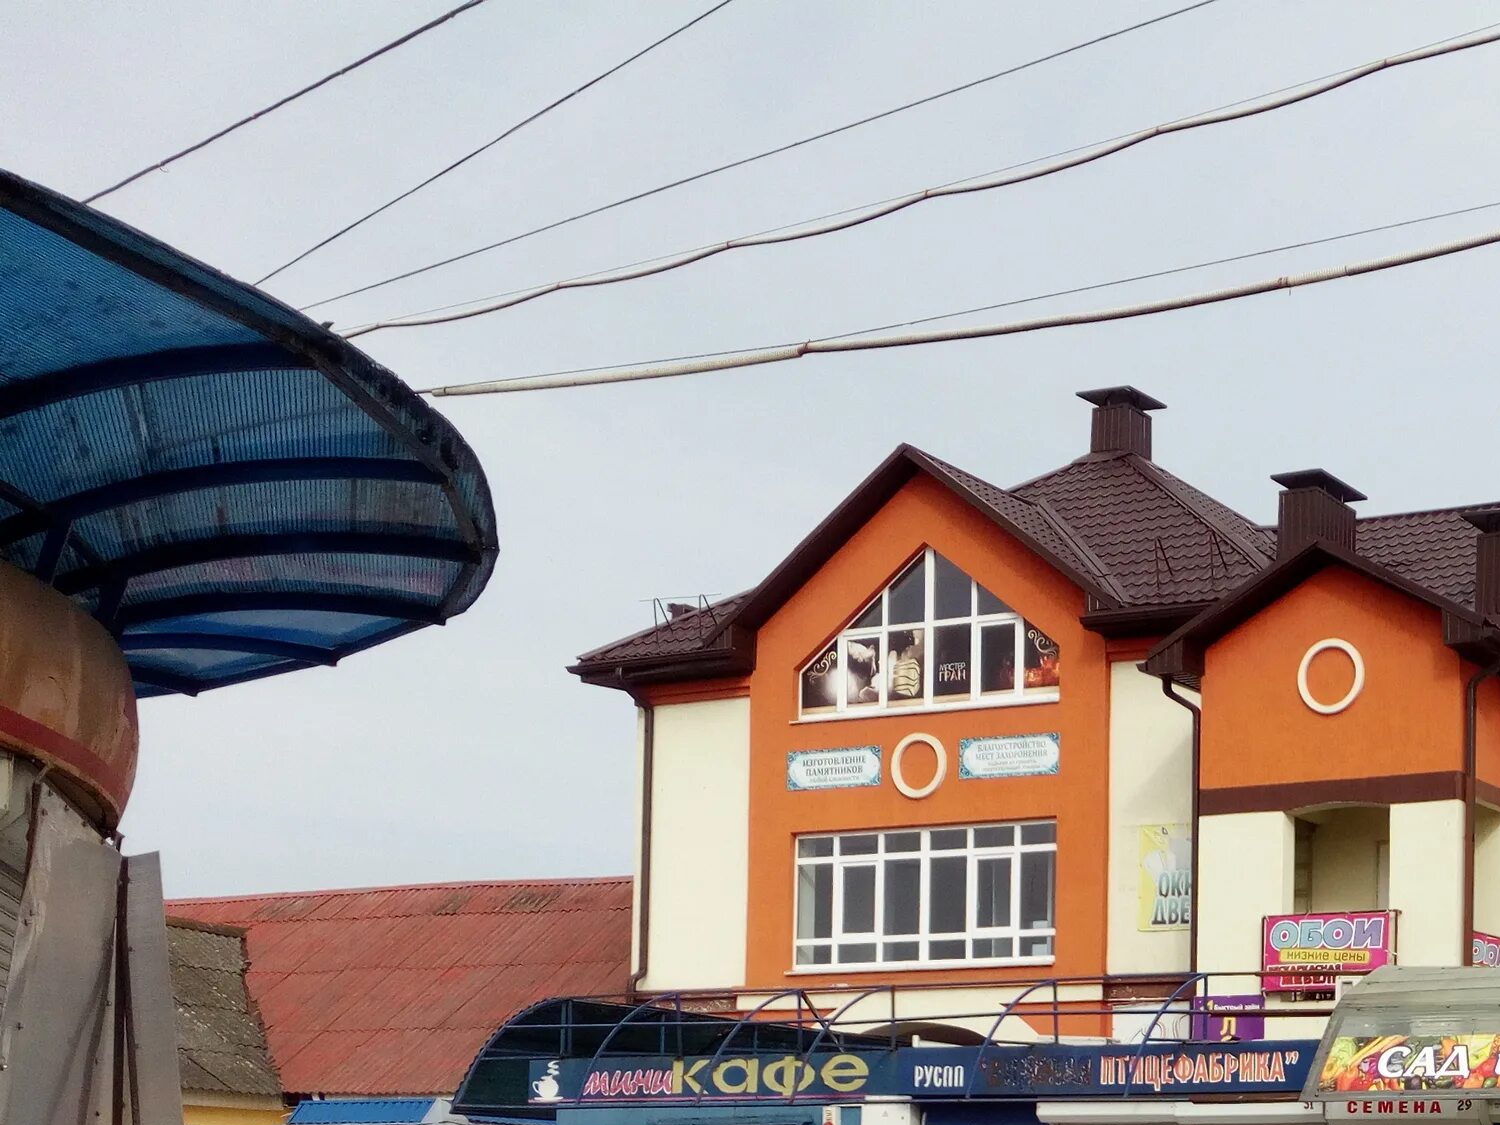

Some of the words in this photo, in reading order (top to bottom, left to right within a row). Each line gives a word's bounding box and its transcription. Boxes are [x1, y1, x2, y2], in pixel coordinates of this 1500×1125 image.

[1270, 917, 1385, 951] ОБОИ
[1286, 952, 1330, 961] низкие
[1333, 951, 1366, 962] цены
[1376, 1044, 1471, 1079] САД
[1347, 1101, 1442, 1114] СЕМЕНА
[1457, 1099, 1472, 1111] 29
